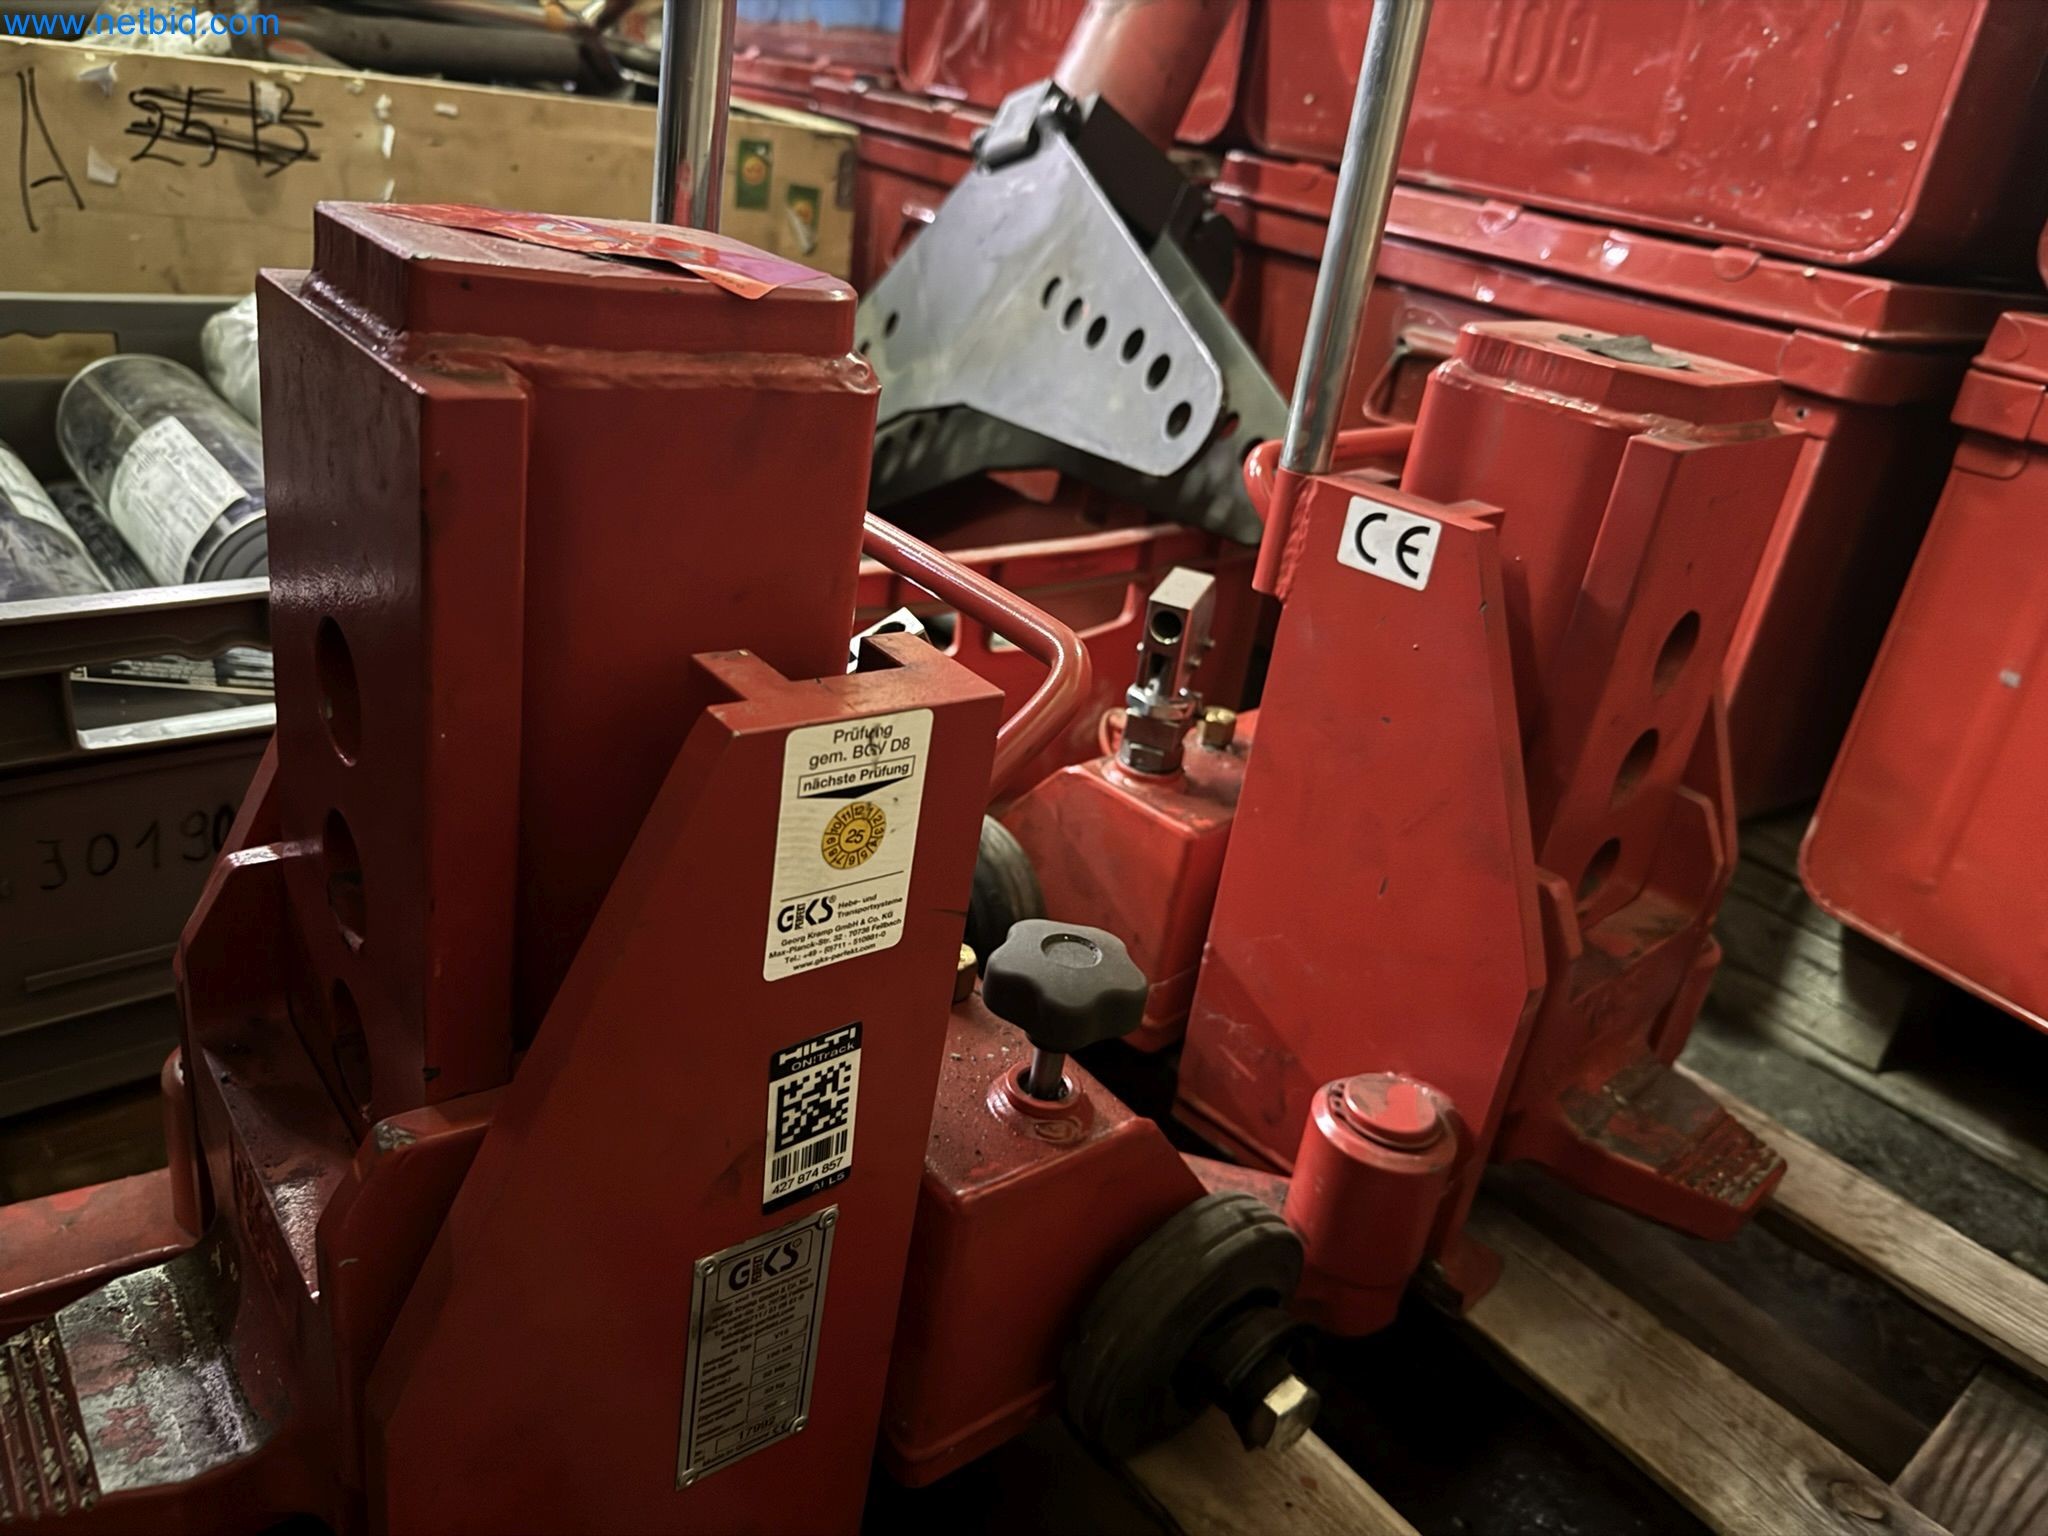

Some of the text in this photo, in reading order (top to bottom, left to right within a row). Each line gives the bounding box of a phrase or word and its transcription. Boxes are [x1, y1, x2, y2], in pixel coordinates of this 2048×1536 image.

[16, 66, 85, 232] A
[1355, 512, 1431, 580] CE
[833, 725, 893, 744] Prüfung
[809, 751, 847, 770] gem.
[890, 737, 911, 752] D8
[803, 763, 910, 792] nächste Prüfung
[845, 829, 866, 844] 25
[837, 897, 903, 918] Transportsysteme
[838, 894, 877, 909] Hebe- und
[835, 919, 859, 932] GmbH
[882, 911, 893, 920] KG
[778, 1027, 857, 1066] HILTI
[791, 1042, 855, 1071] ON!Track
[772, 1156, 843, 1194] 427 874 857
